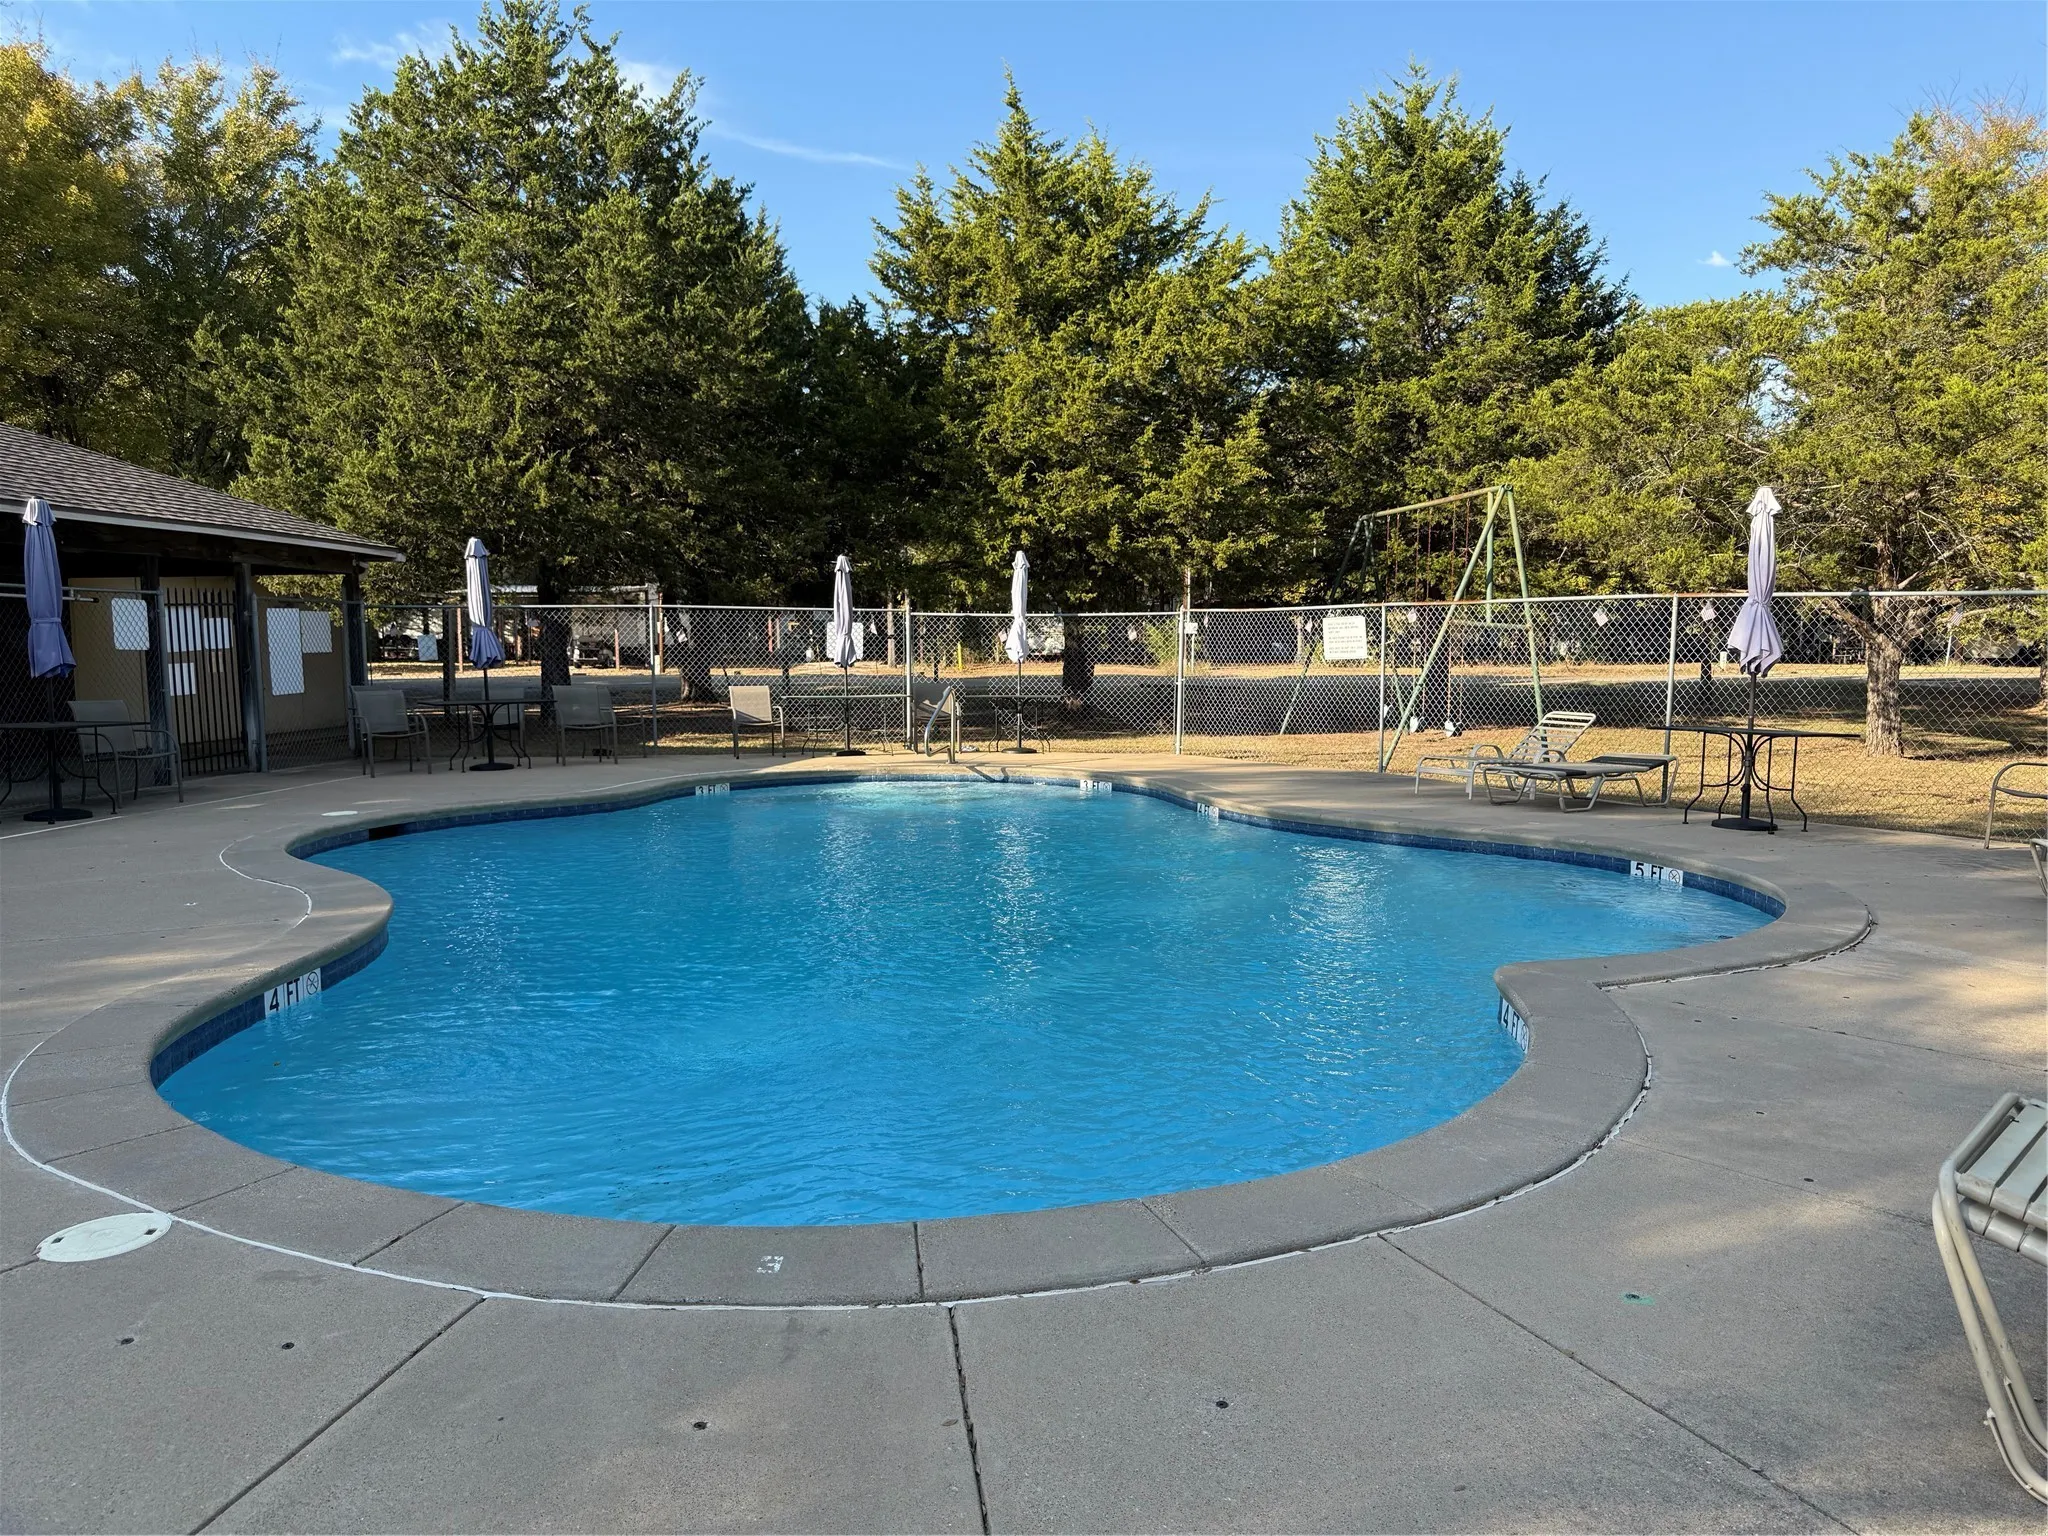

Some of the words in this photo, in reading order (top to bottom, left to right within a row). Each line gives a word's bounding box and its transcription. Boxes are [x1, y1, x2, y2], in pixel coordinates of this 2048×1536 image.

[1634, 862, 1644, 877] 5
[1651, 865, 1664, 880] FT
[269, 987, 279, 1012] 4
[286, 978, 300, 1006] FT
[1503, 1004, 1509, 1029] 4
[1511, 1011, 1519, 1040] FT
